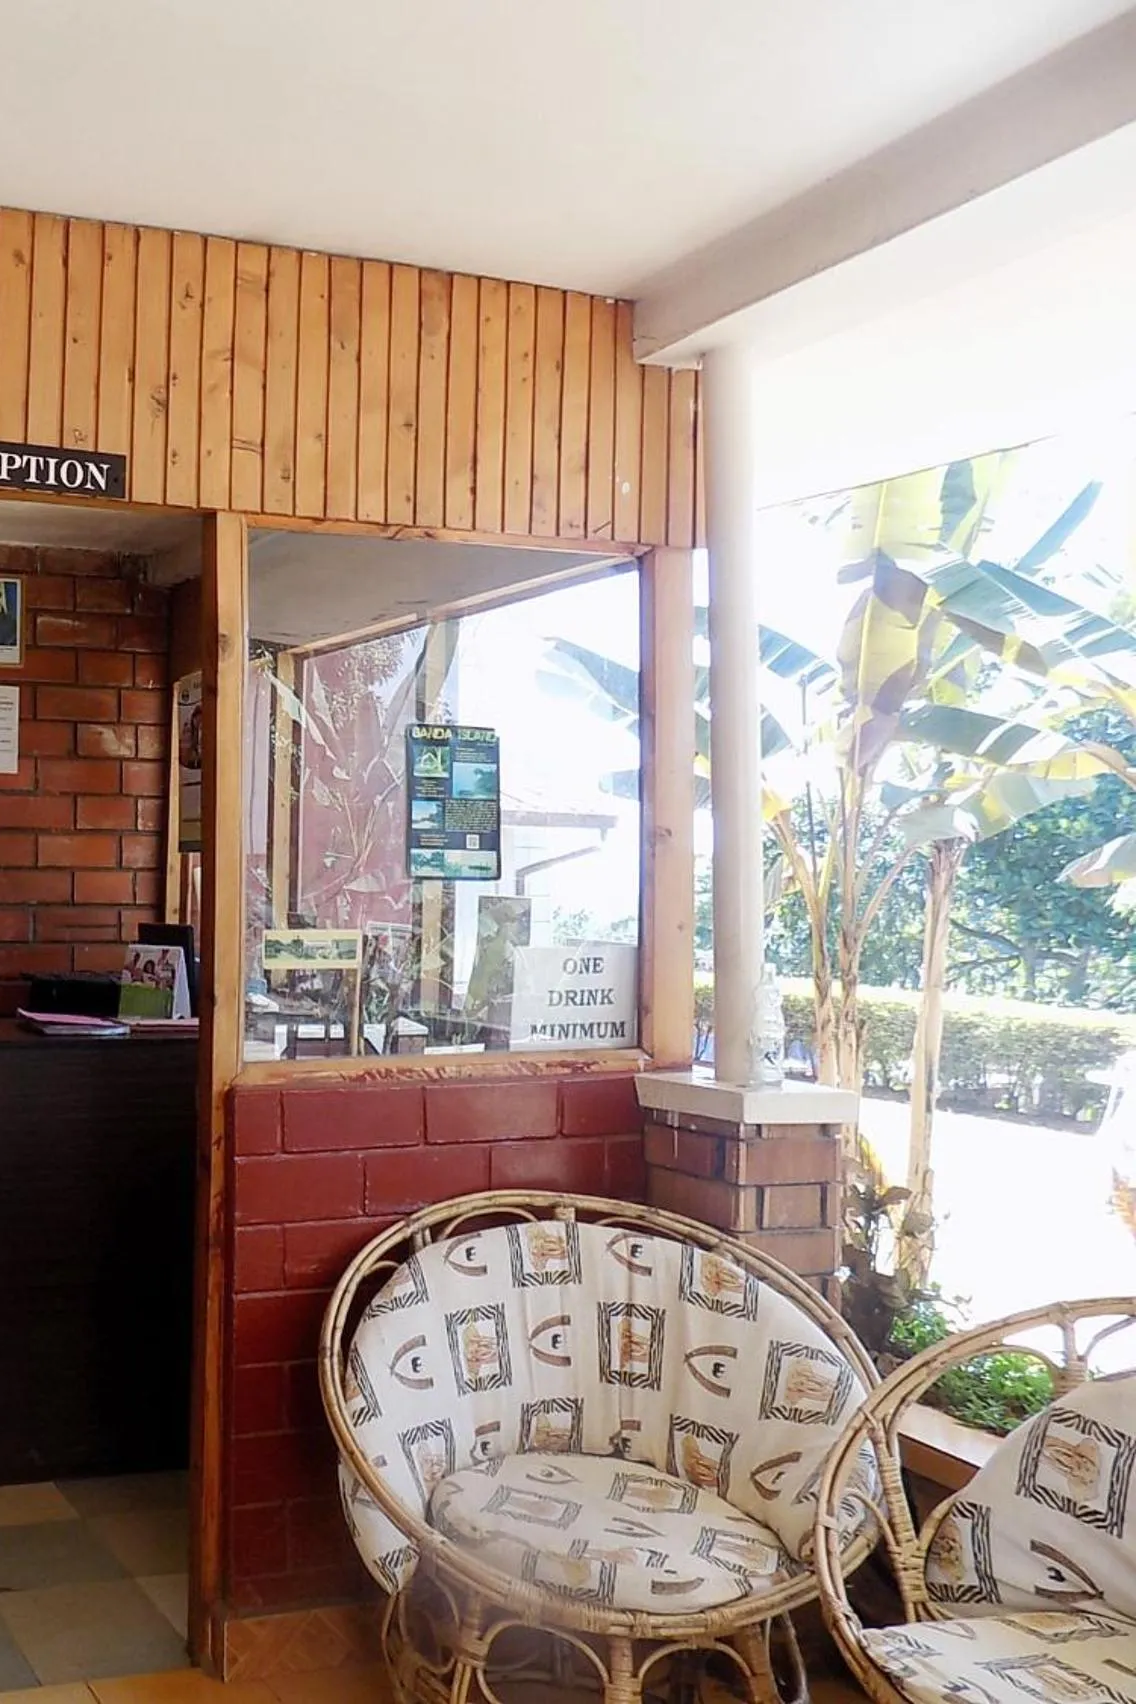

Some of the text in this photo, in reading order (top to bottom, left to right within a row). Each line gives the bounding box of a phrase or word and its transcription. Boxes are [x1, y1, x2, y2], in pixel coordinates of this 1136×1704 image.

[563, 957, 604, 975] ONE
[548, 988, 615, 1007] DRINK
[530, 1021, 626, 1039] MINIMUM
